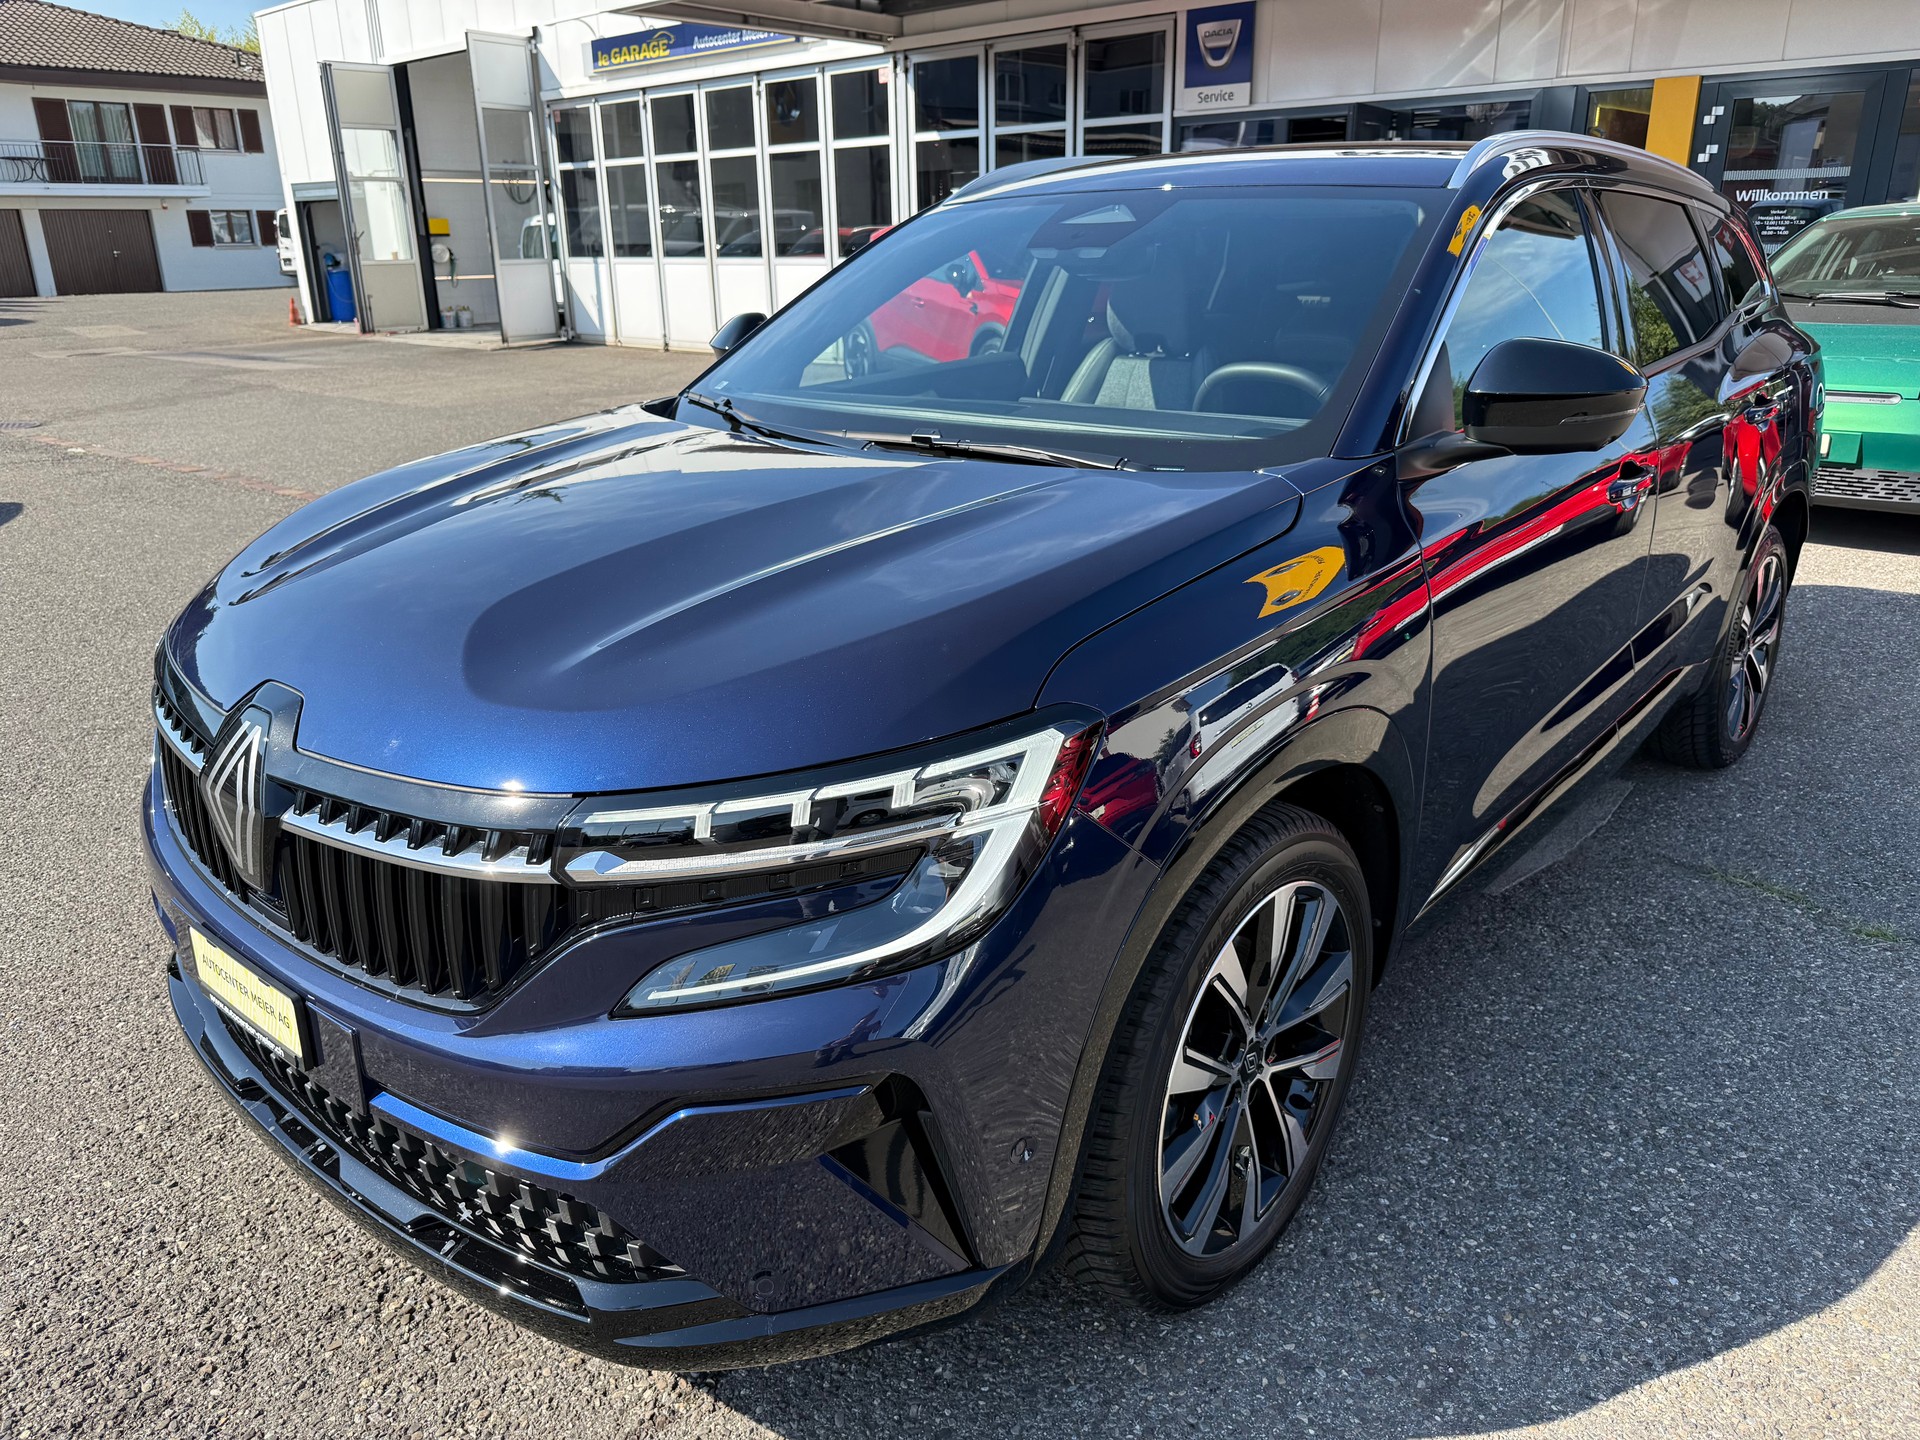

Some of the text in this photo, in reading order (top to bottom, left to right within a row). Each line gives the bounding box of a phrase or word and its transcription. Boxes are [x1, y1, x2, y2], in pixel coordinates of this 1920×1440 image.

[693, 31, 741, 49] Autocenter
[1203, 28, 1233, 38] DACIA
[598, 39, 670, 66] le GARAGE
[1197, 90, 1234, 104] Service
[1736, 188, 1829, 202] Willkommen
[203, 954, 290, 1029] AUTOCENTER MEIER AG
